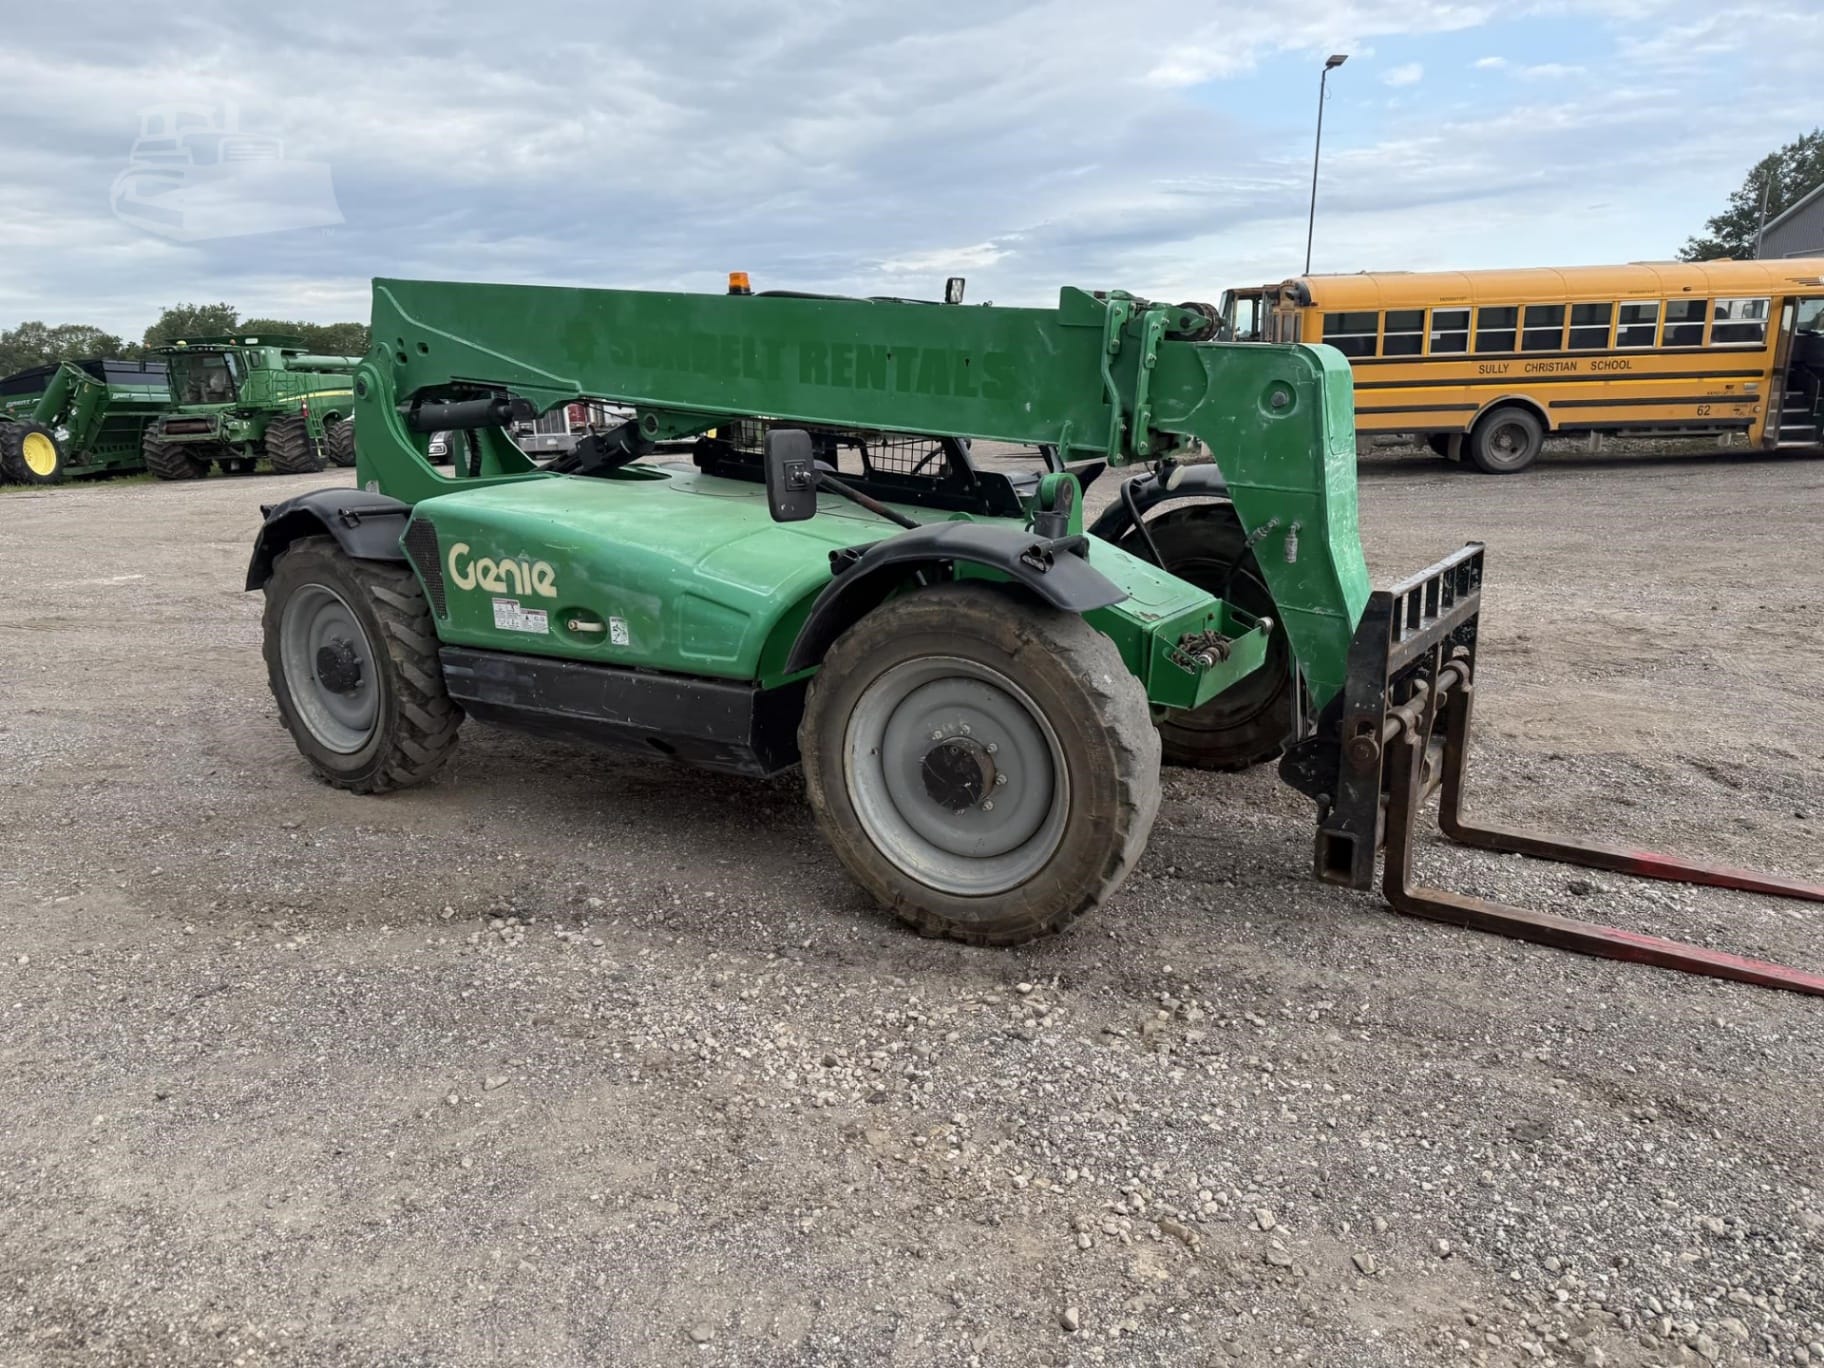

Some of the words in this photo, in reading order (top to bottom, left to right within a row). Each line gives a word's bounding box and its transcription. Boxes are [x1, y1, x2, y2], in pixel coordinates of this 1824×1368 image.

[799, 341, 1019, 399] RENTALS
[1478, 363, 1510, 375] SULLY
[1524, 361, 1578, 373] CHRISTIAN
[1590, 360, 1633, 371] SCHOOL
[1696, 404, 1711, 416] 62
[448, 542, 558, 598] Genie
